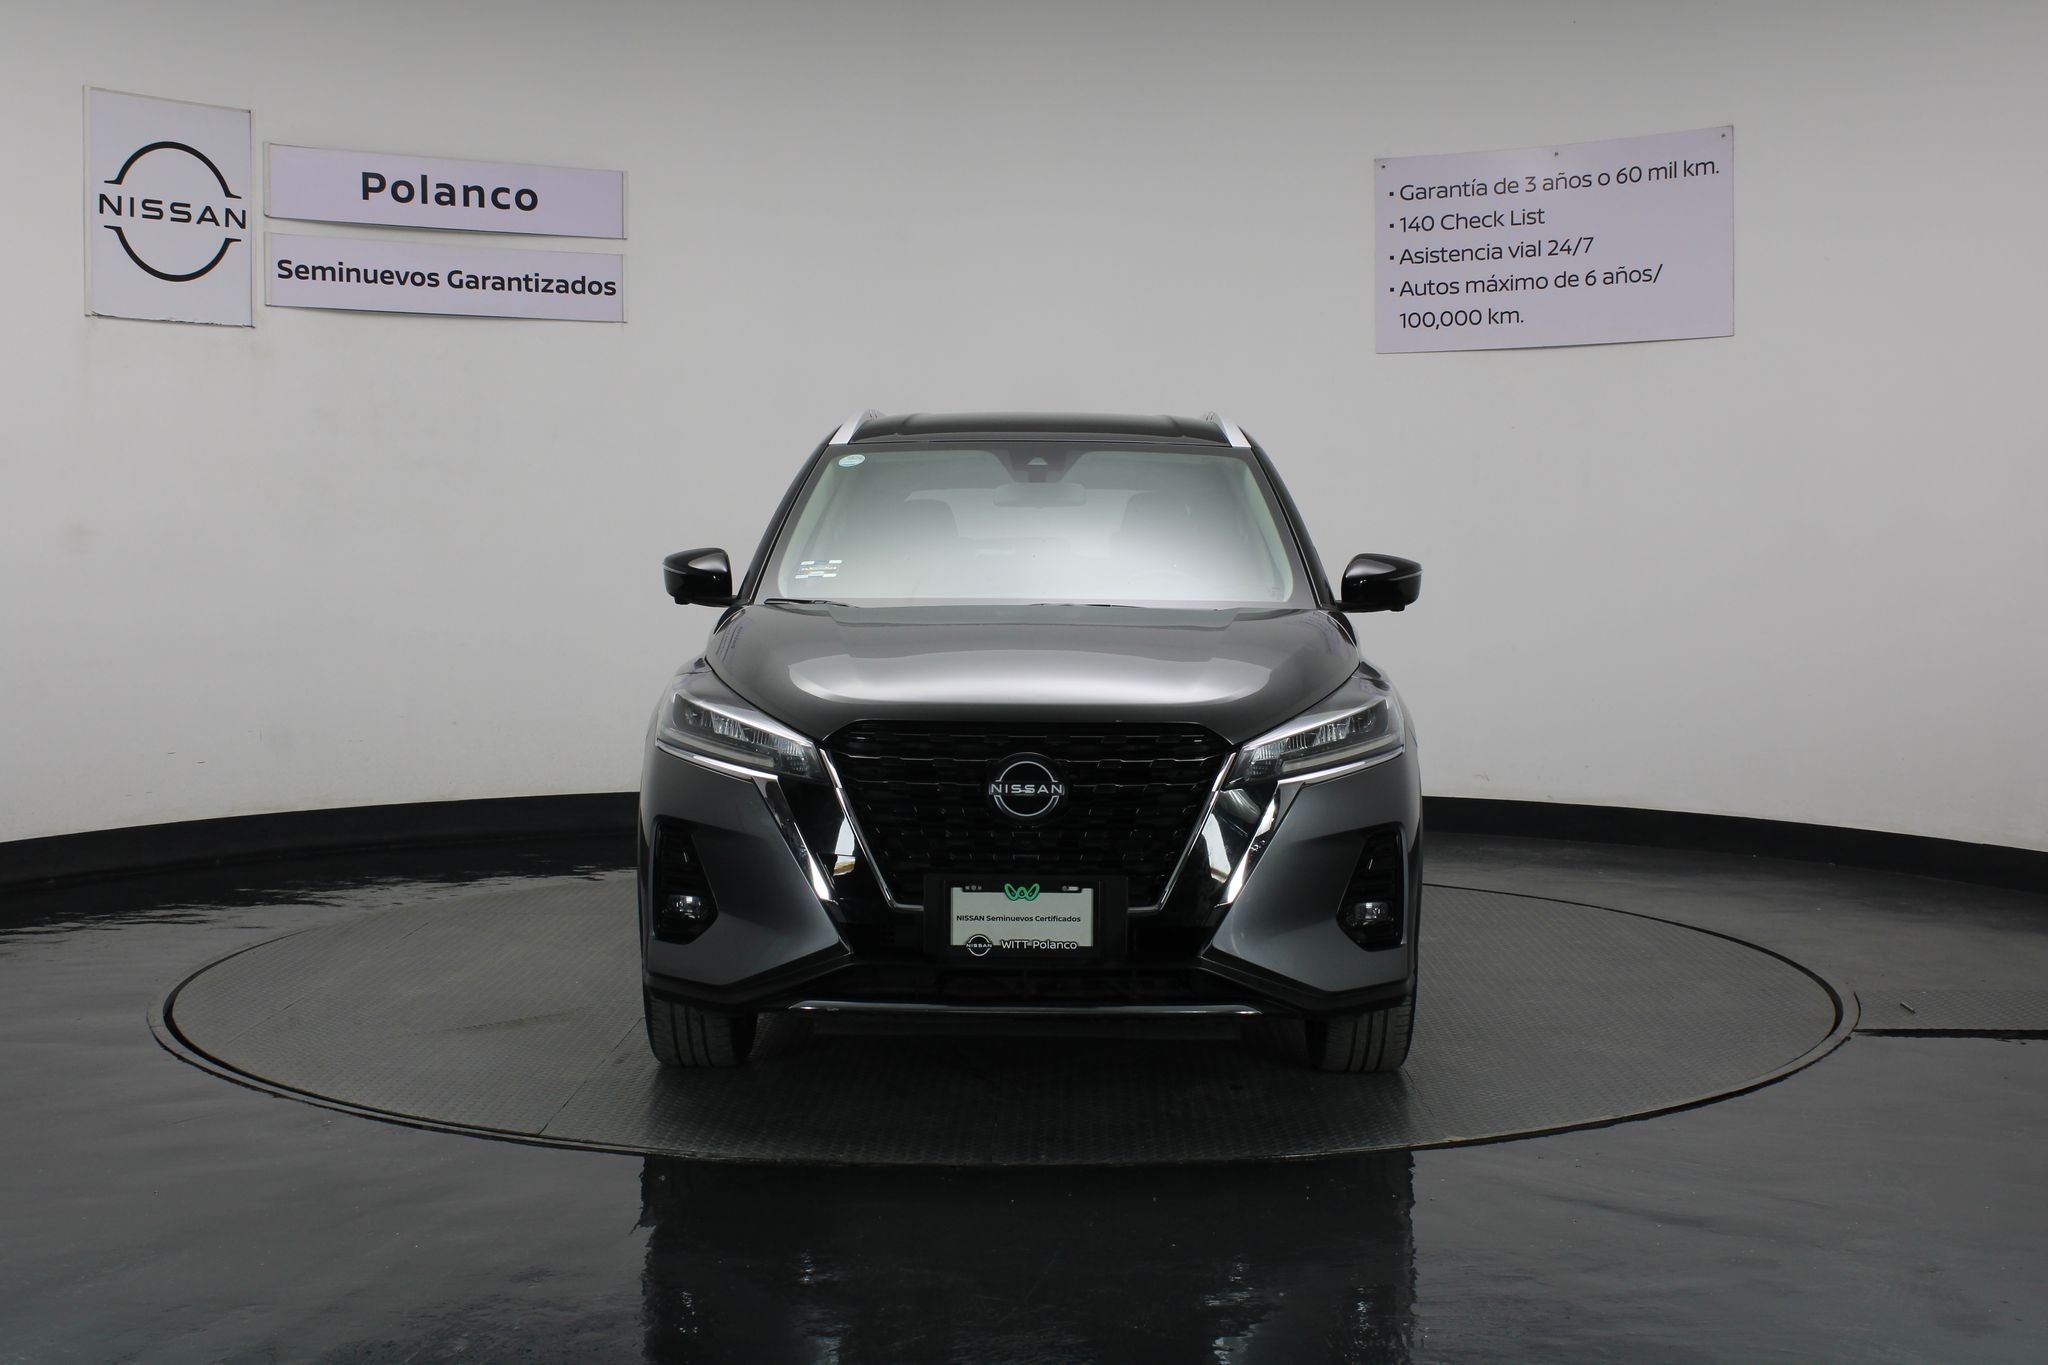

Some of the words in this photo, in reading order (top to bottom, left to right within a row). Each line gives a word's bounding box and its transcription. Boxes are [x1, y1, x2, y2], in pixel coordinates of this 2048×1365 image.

[361, 172, 540, 211] Polanco
[1400, 178, 1488, 201] Garantía
[1494, 177, 1519, 194] de
[1524, 176, 1536, 193] 3
[1542, 171, 1592, 191] años
[1597, 171, 1611, 187] o
[1616, 166, 1642, 184] 60
[1648, 161, 1678, 180] mil
[1683, 159, 1720, 178] km.
[98, 194, 247, 230] NISSAN
[1400, 215, 1435, 232] 140
[1441, 210, 1505, 230] Check
[1510, 208, 1546, 226] List
[1400, 244, 1503, 265] Asistencia
[1508, 240, 1542, 259] vial
[1547, 237, 1594, 257] 24/7
[276, 258, 441, 289] Seminuevos
[446, 269, 618, 297] Garantizados
[1400, 279, 1460, 297] Autos
[1465, 273, 1549, 293] máximo
[1554, 271, 1579, 287] de
[1585, 269, 1597, 286] 6
[1602, 264, 1663, 285] años/
[1400, 309, 1482, 331] 100,000
[1488, 308, 1525, 325] km.
[991, 783, 1062, 794] NISSAN
[1035, 915, 1081, 923] Certificados
[1001, 940, 1029, 950] WITT
[1032, 940, 1078, 950] Polanco
